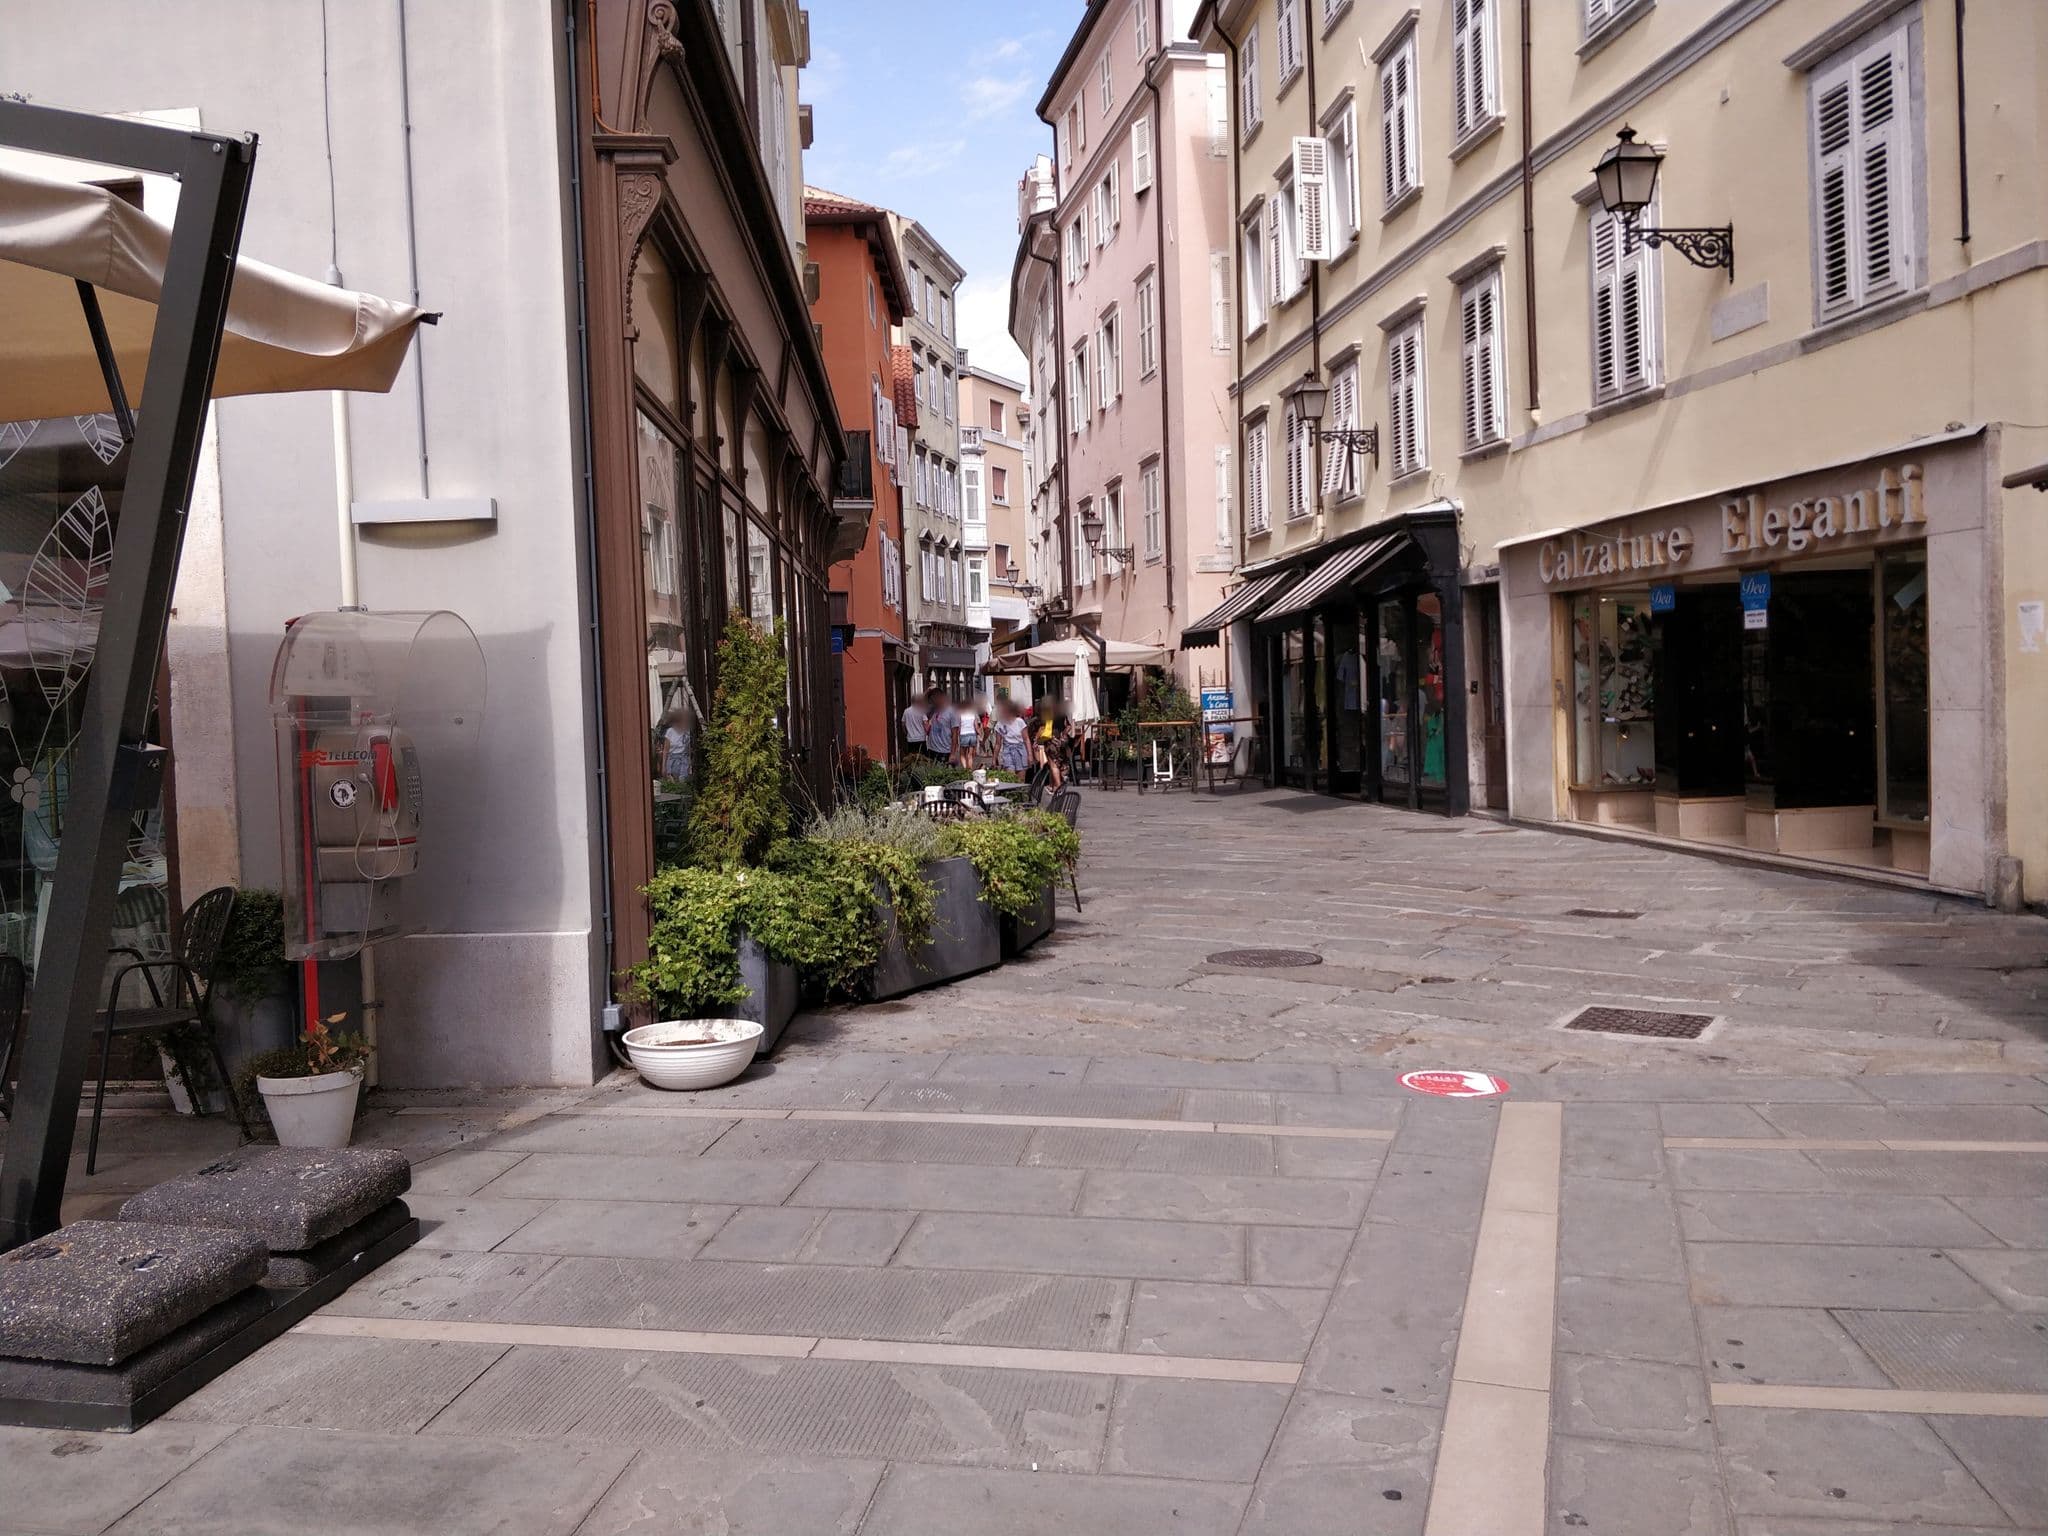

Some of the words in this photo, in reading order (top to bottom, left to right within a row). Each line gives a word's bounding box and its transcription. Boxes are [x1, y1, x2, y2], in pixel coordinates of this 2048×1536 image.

[1538, 525, 1694, 584] Calzature
[1720, 463, 1927, 554] Eleganti
[1742, 577, 1768, 594] Dea
[1652, 590, 1672, 605] Dea
